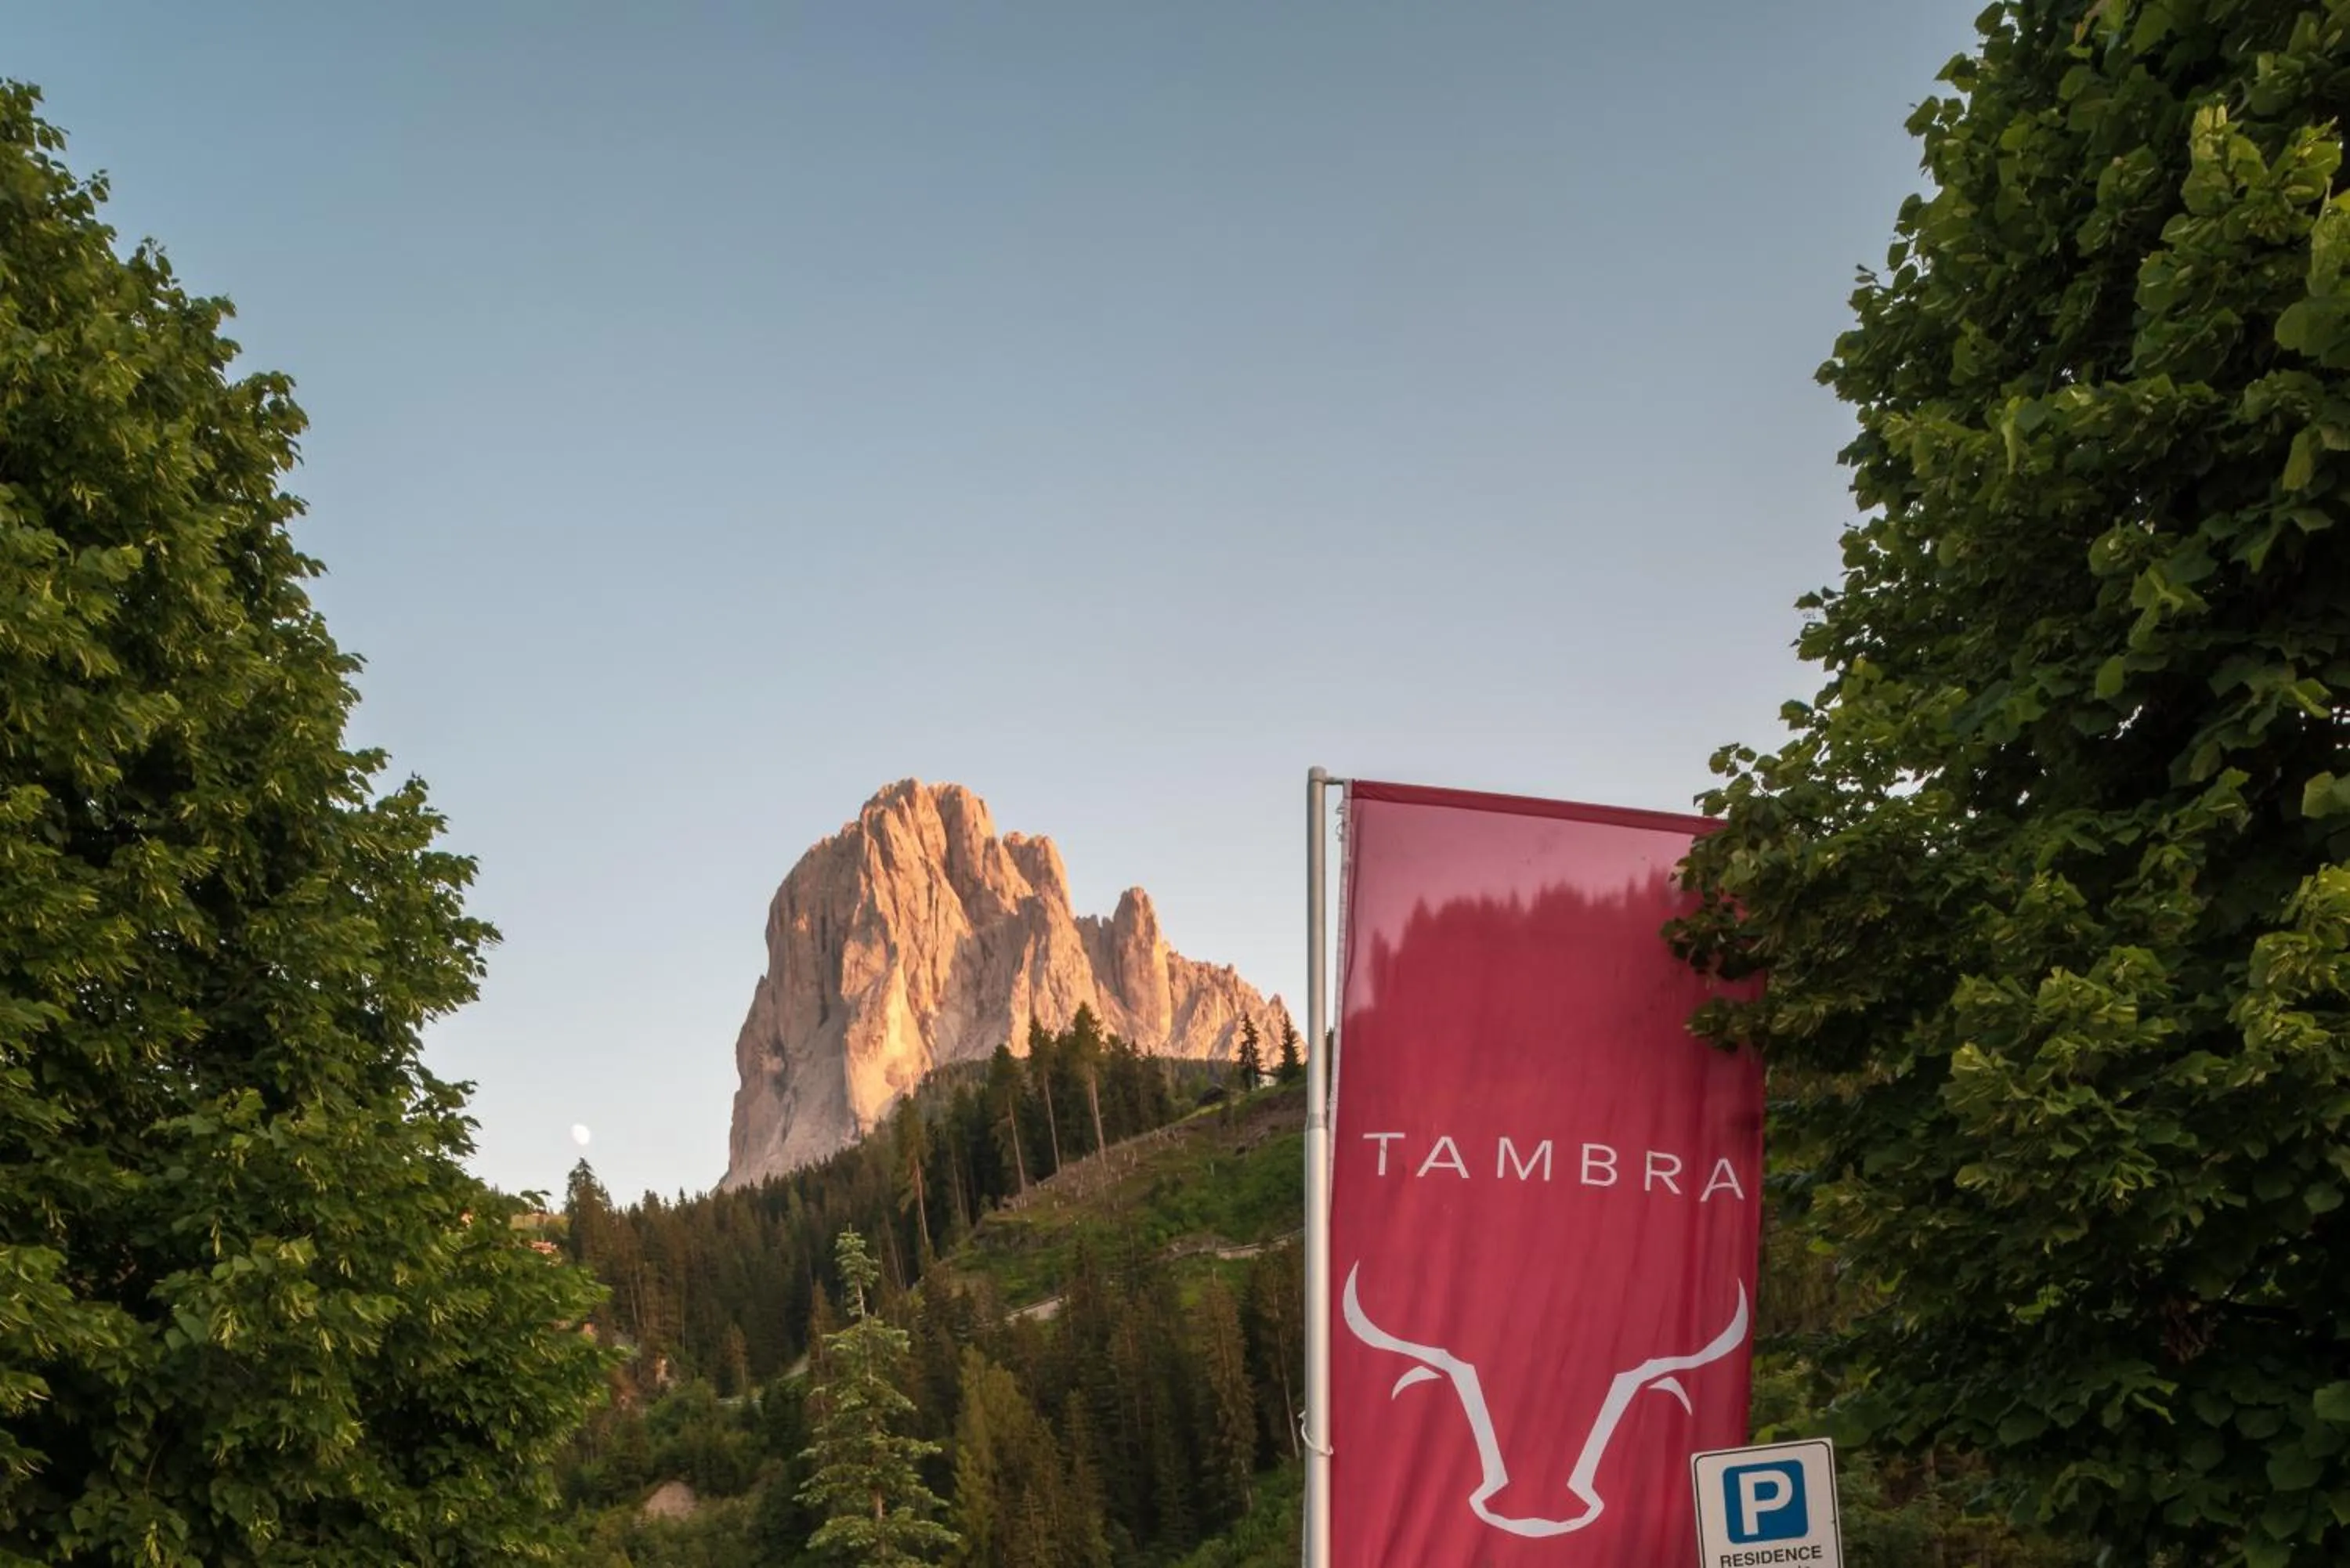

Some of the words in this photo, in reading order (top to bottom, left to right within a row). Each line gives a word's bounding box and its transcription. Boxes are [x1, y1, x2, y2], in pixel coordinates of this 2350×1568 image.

[1363, 1133, 1744, 1202] TAMBRA
[1738, 1470, 1793, 1536] P
[1720, 1545, 1823, 1568] RESIDENCE
